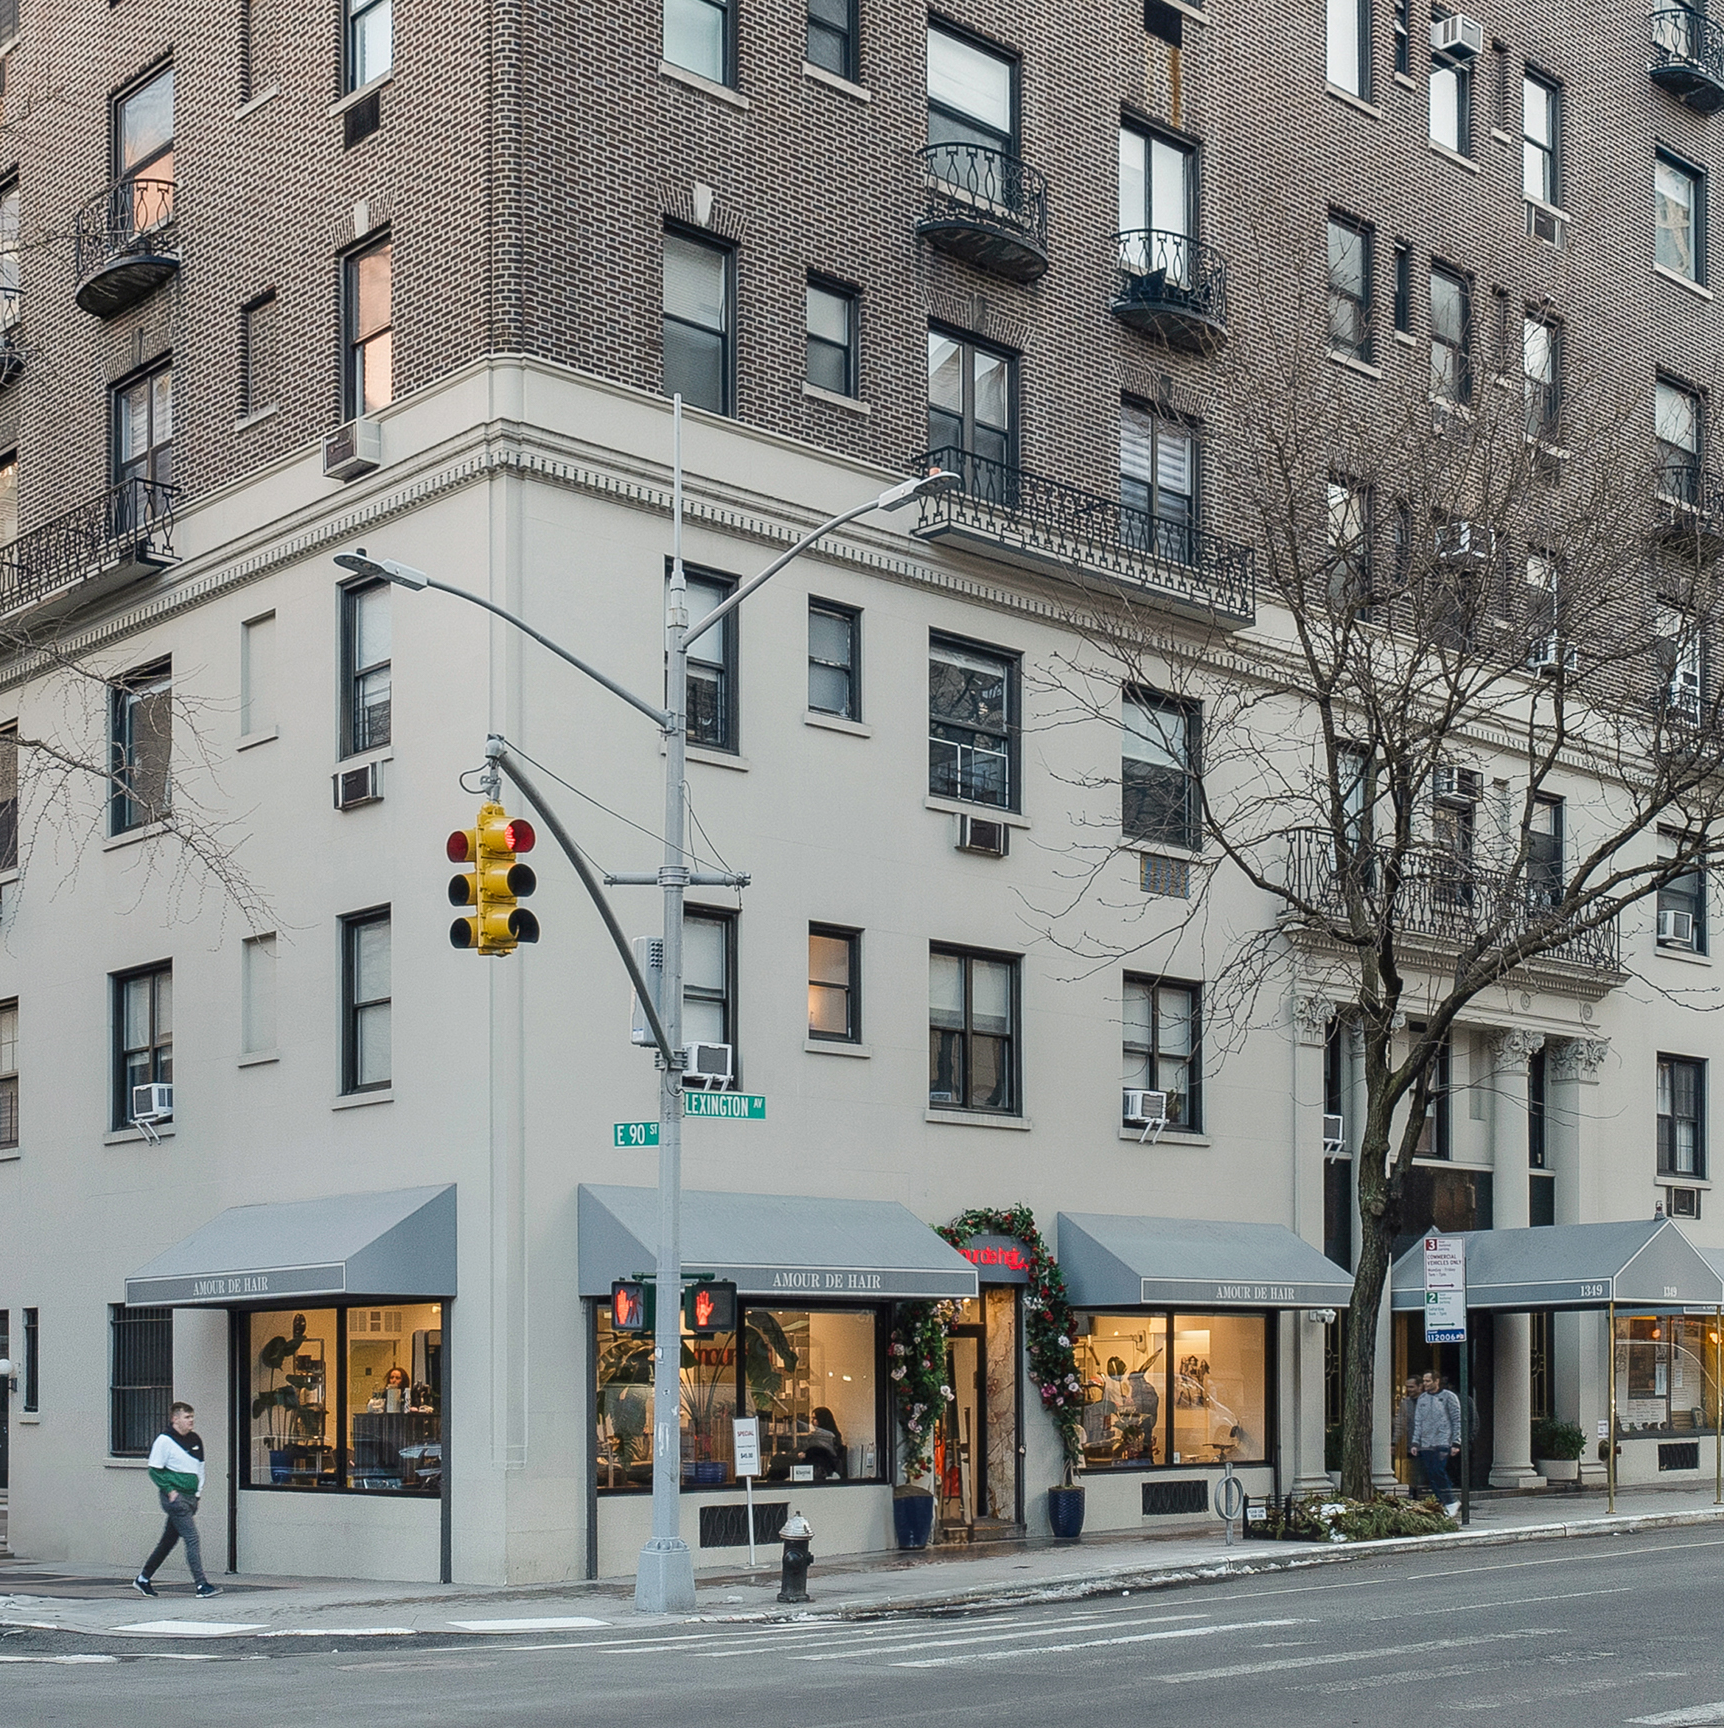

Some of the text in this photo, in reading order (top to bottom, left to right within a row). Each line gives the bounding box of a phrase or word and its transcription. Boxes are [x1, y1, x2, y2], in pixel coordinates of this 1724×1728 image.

[685, 1093, 763, 1117] LEXINGTON AV
[617, 1124, 658, 1145] E 90 ST
[1428, 1239, 1436, 1250] 3
[193, 1276, 269, 1296] AMOUR DE HAIR
[772, 1272, 881, 1289] AMOUR DE HAIR
[1216, 1285, 1295, 1300] AMOUR DE HAIR
[1429, 1292, 1436, 1303] 2
[1580, 1284, 1603, 1297] 1349
[1663, 1286, 1677, 1298] 1349
[1428, 1333, 1456, 1342] 112006
